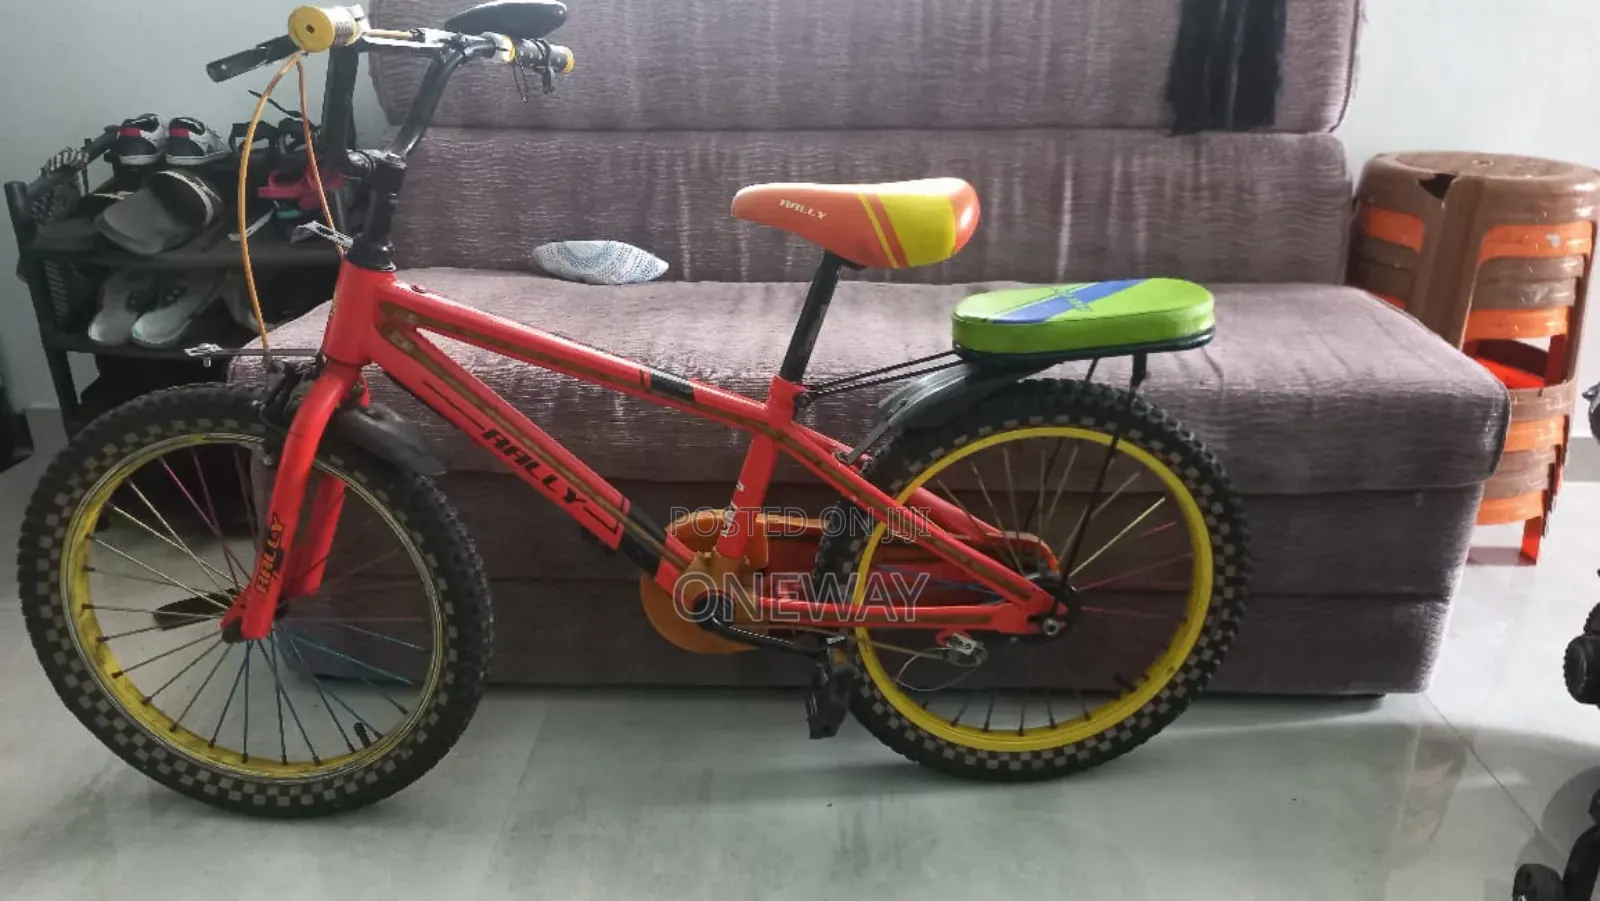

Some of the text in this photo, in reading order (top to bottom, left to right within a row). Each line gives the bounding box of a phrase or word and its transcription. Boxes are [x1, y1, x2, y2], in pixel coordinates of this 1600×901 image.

[778, 198, 828, 220] RALLY
[482, 428, 586, 504] RALLY
[254, 511, 286, 596] RALLY
